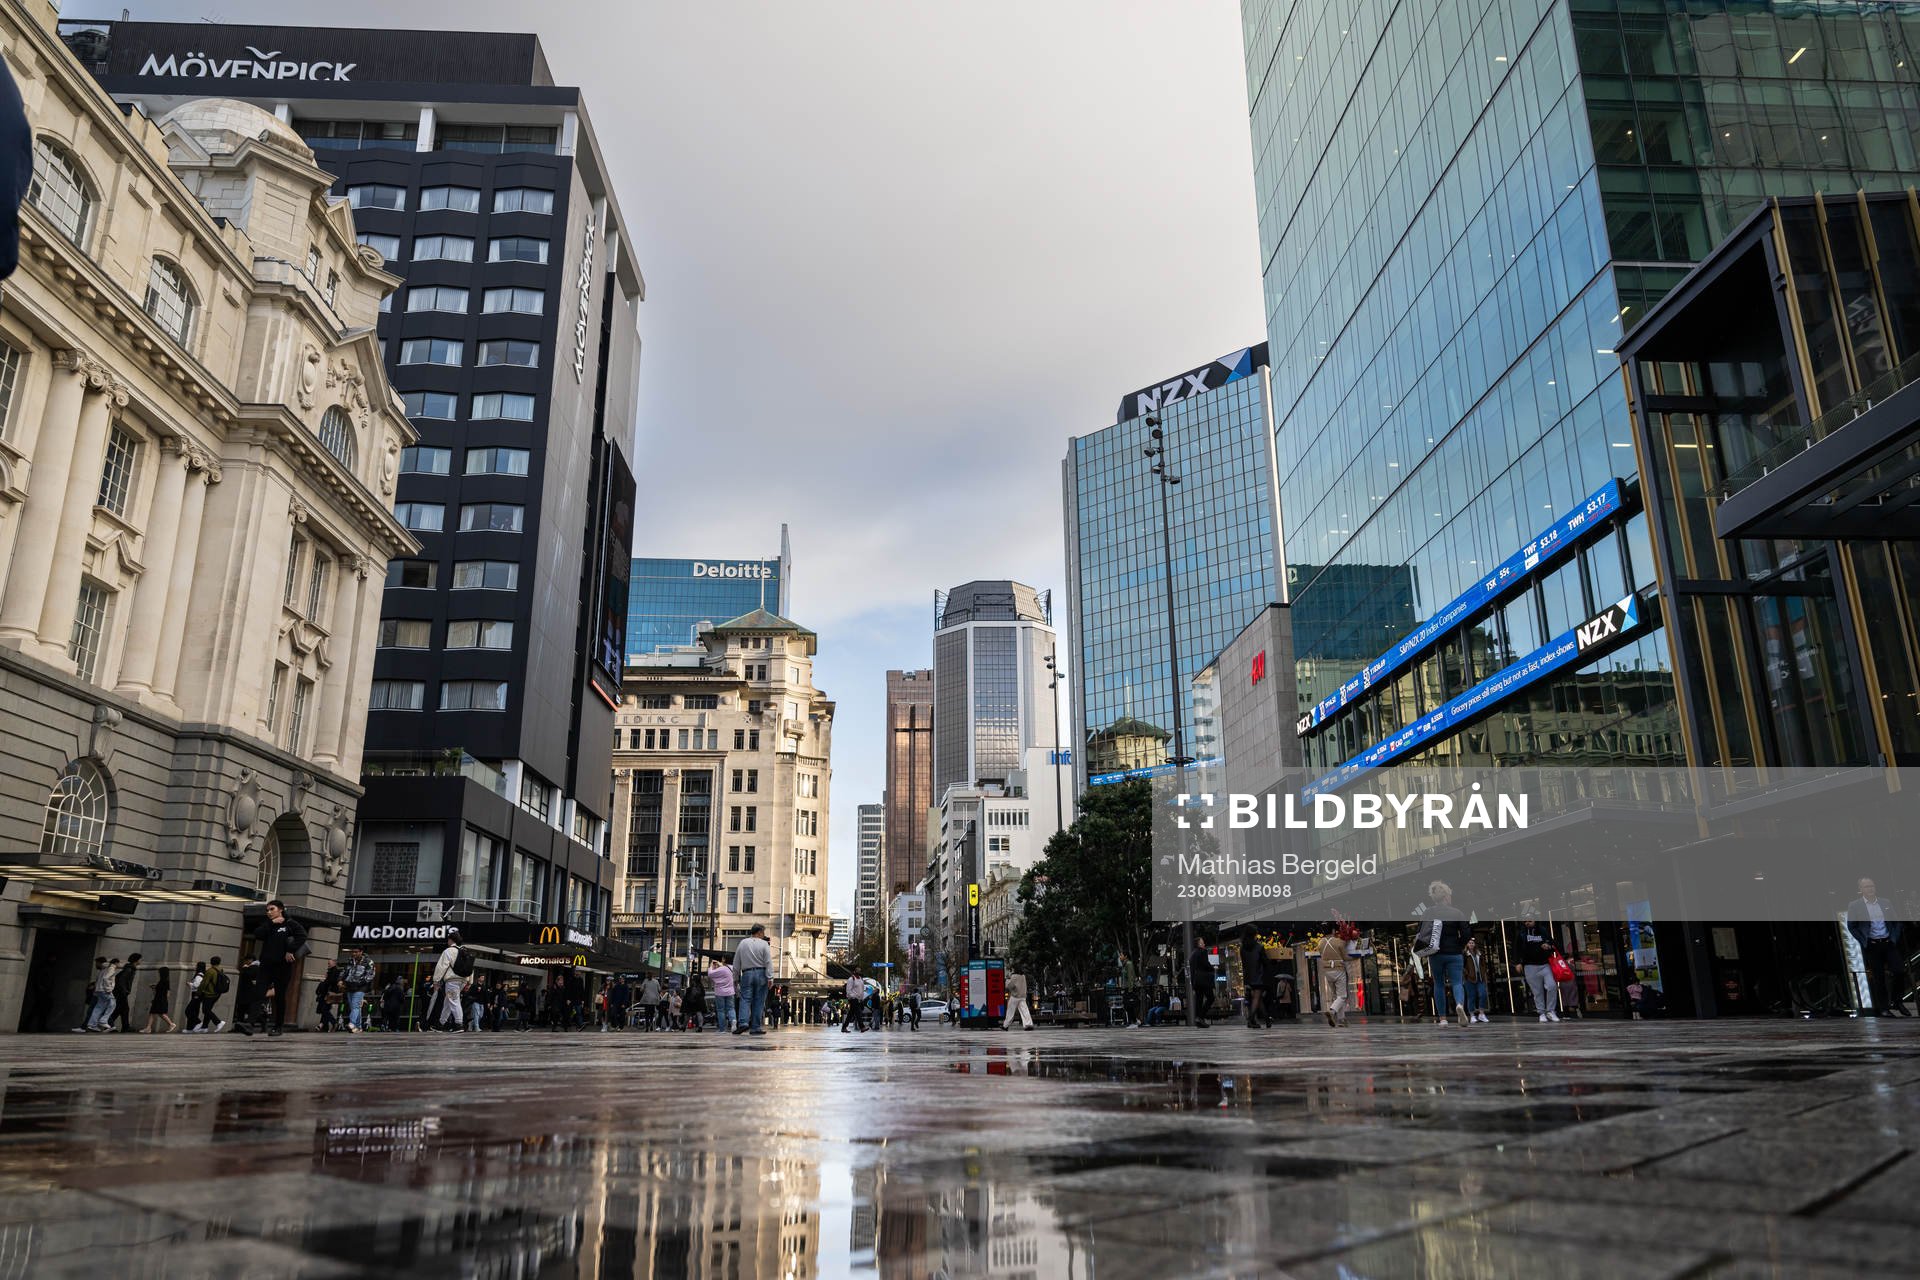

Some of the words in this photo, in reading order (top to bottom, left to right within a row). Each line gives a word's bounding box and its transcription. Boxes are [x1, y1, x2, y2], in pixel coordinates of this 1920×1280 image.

[138, 50, 357, 82] MÖVENPICK
[1137, 367, 1211, 417] NZX
[1567, 512, 1585, 531] TWH
[1586, 492, 1607, 515] $3.17
[1523, 541, 1538, 558] TWF
[1540, 530, 1558, 549] $3.18
[1426, 621, 1440, 637] Index
[1439, 601, 1468, 627] Companies
[1576, 609, 1618, 651] NZX
[1450, 701, 1468, 716] Grocery
[1468, 695, 1482, 710] prices
[1481, 686, 1490, 699] still
[1490, 682, 1504, 694] rising
[1502, 676, 1513, 688] but
[1512, 670, 1521, 682] not
[1521, 667, 1529, 677] as
[1540, 651, 1556, 666] index
[1296, 714, 1311, 735] NZX
[352, 925, 460, 939] McDonald's
[520, 956, 572, 966] McDonald's
